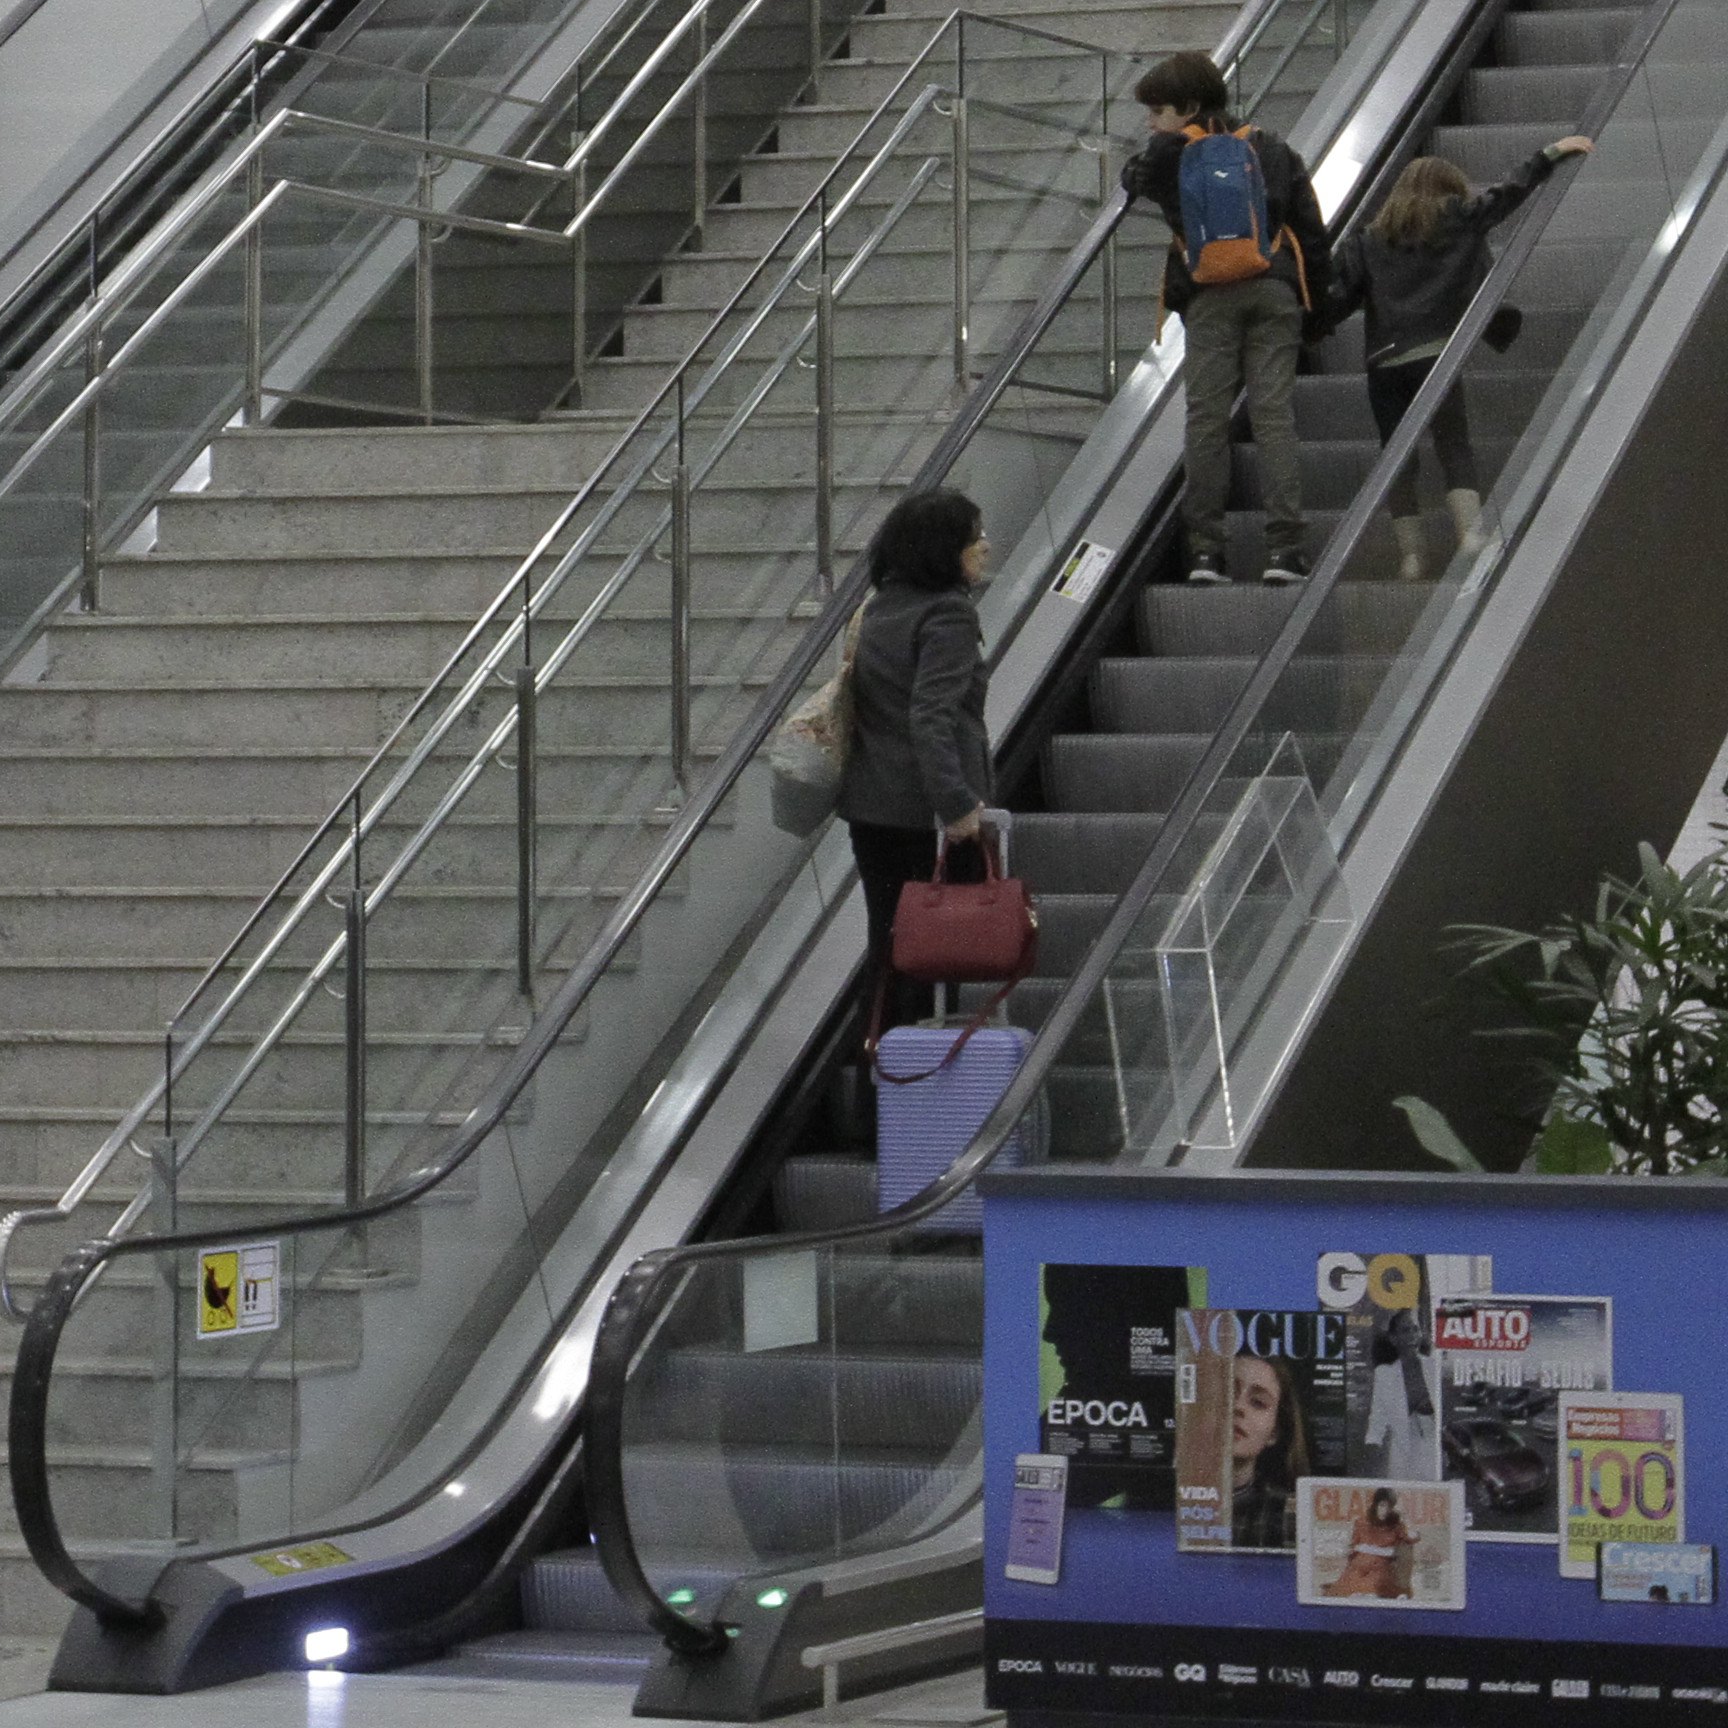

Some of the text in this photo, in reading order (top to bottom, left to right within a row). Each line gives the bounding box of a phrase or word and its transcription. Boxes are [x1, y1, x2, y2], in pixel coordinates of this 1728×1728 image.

[1317, 1252, 1421, 1310] GQ
[1180, 1310, 1345, 1360] VOGUE
[1442, 1309, 1530, 1340] AUTO
[1179, 1486, 1219, 1501] VIDA
[1568, 1448, 1676, 1520] 100
[1174, 1663, 1207, 1682] GQ
